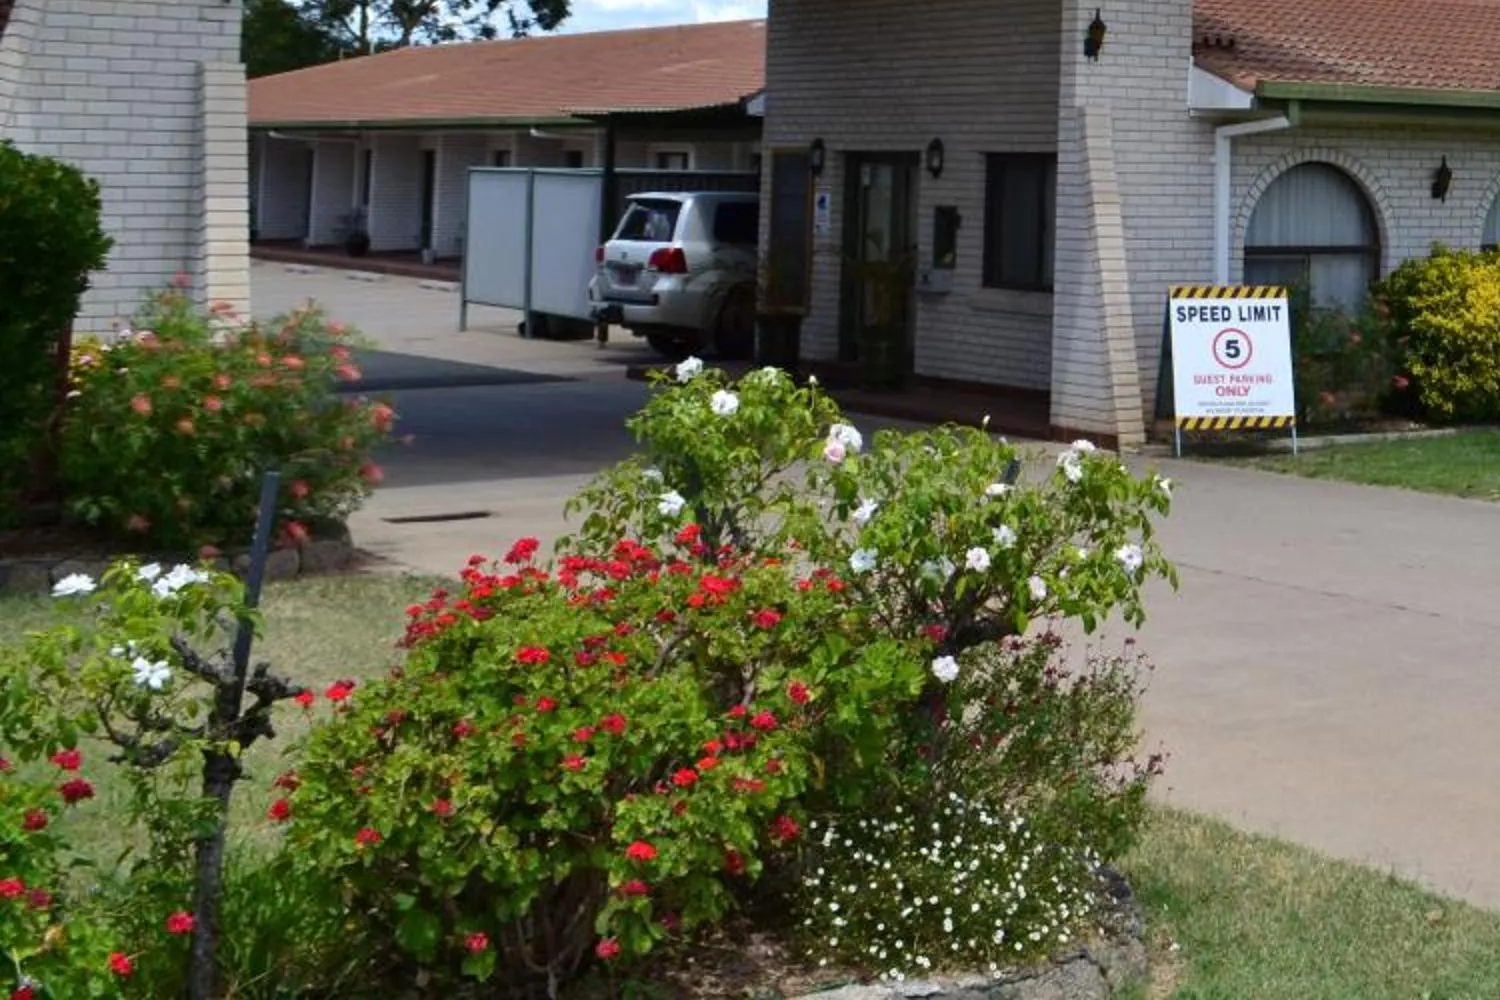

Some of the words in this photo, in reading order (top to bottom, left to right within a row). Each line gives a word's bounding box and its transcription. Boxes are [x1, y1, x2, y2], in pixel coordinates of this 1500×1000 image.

[1176, 305, 1232, 322] SPEED
[1238, 305, 1281, 321] LIMIT
[1225, 339, 1241, 359] 5
[1215, 385, 1251, 398] ONLY
